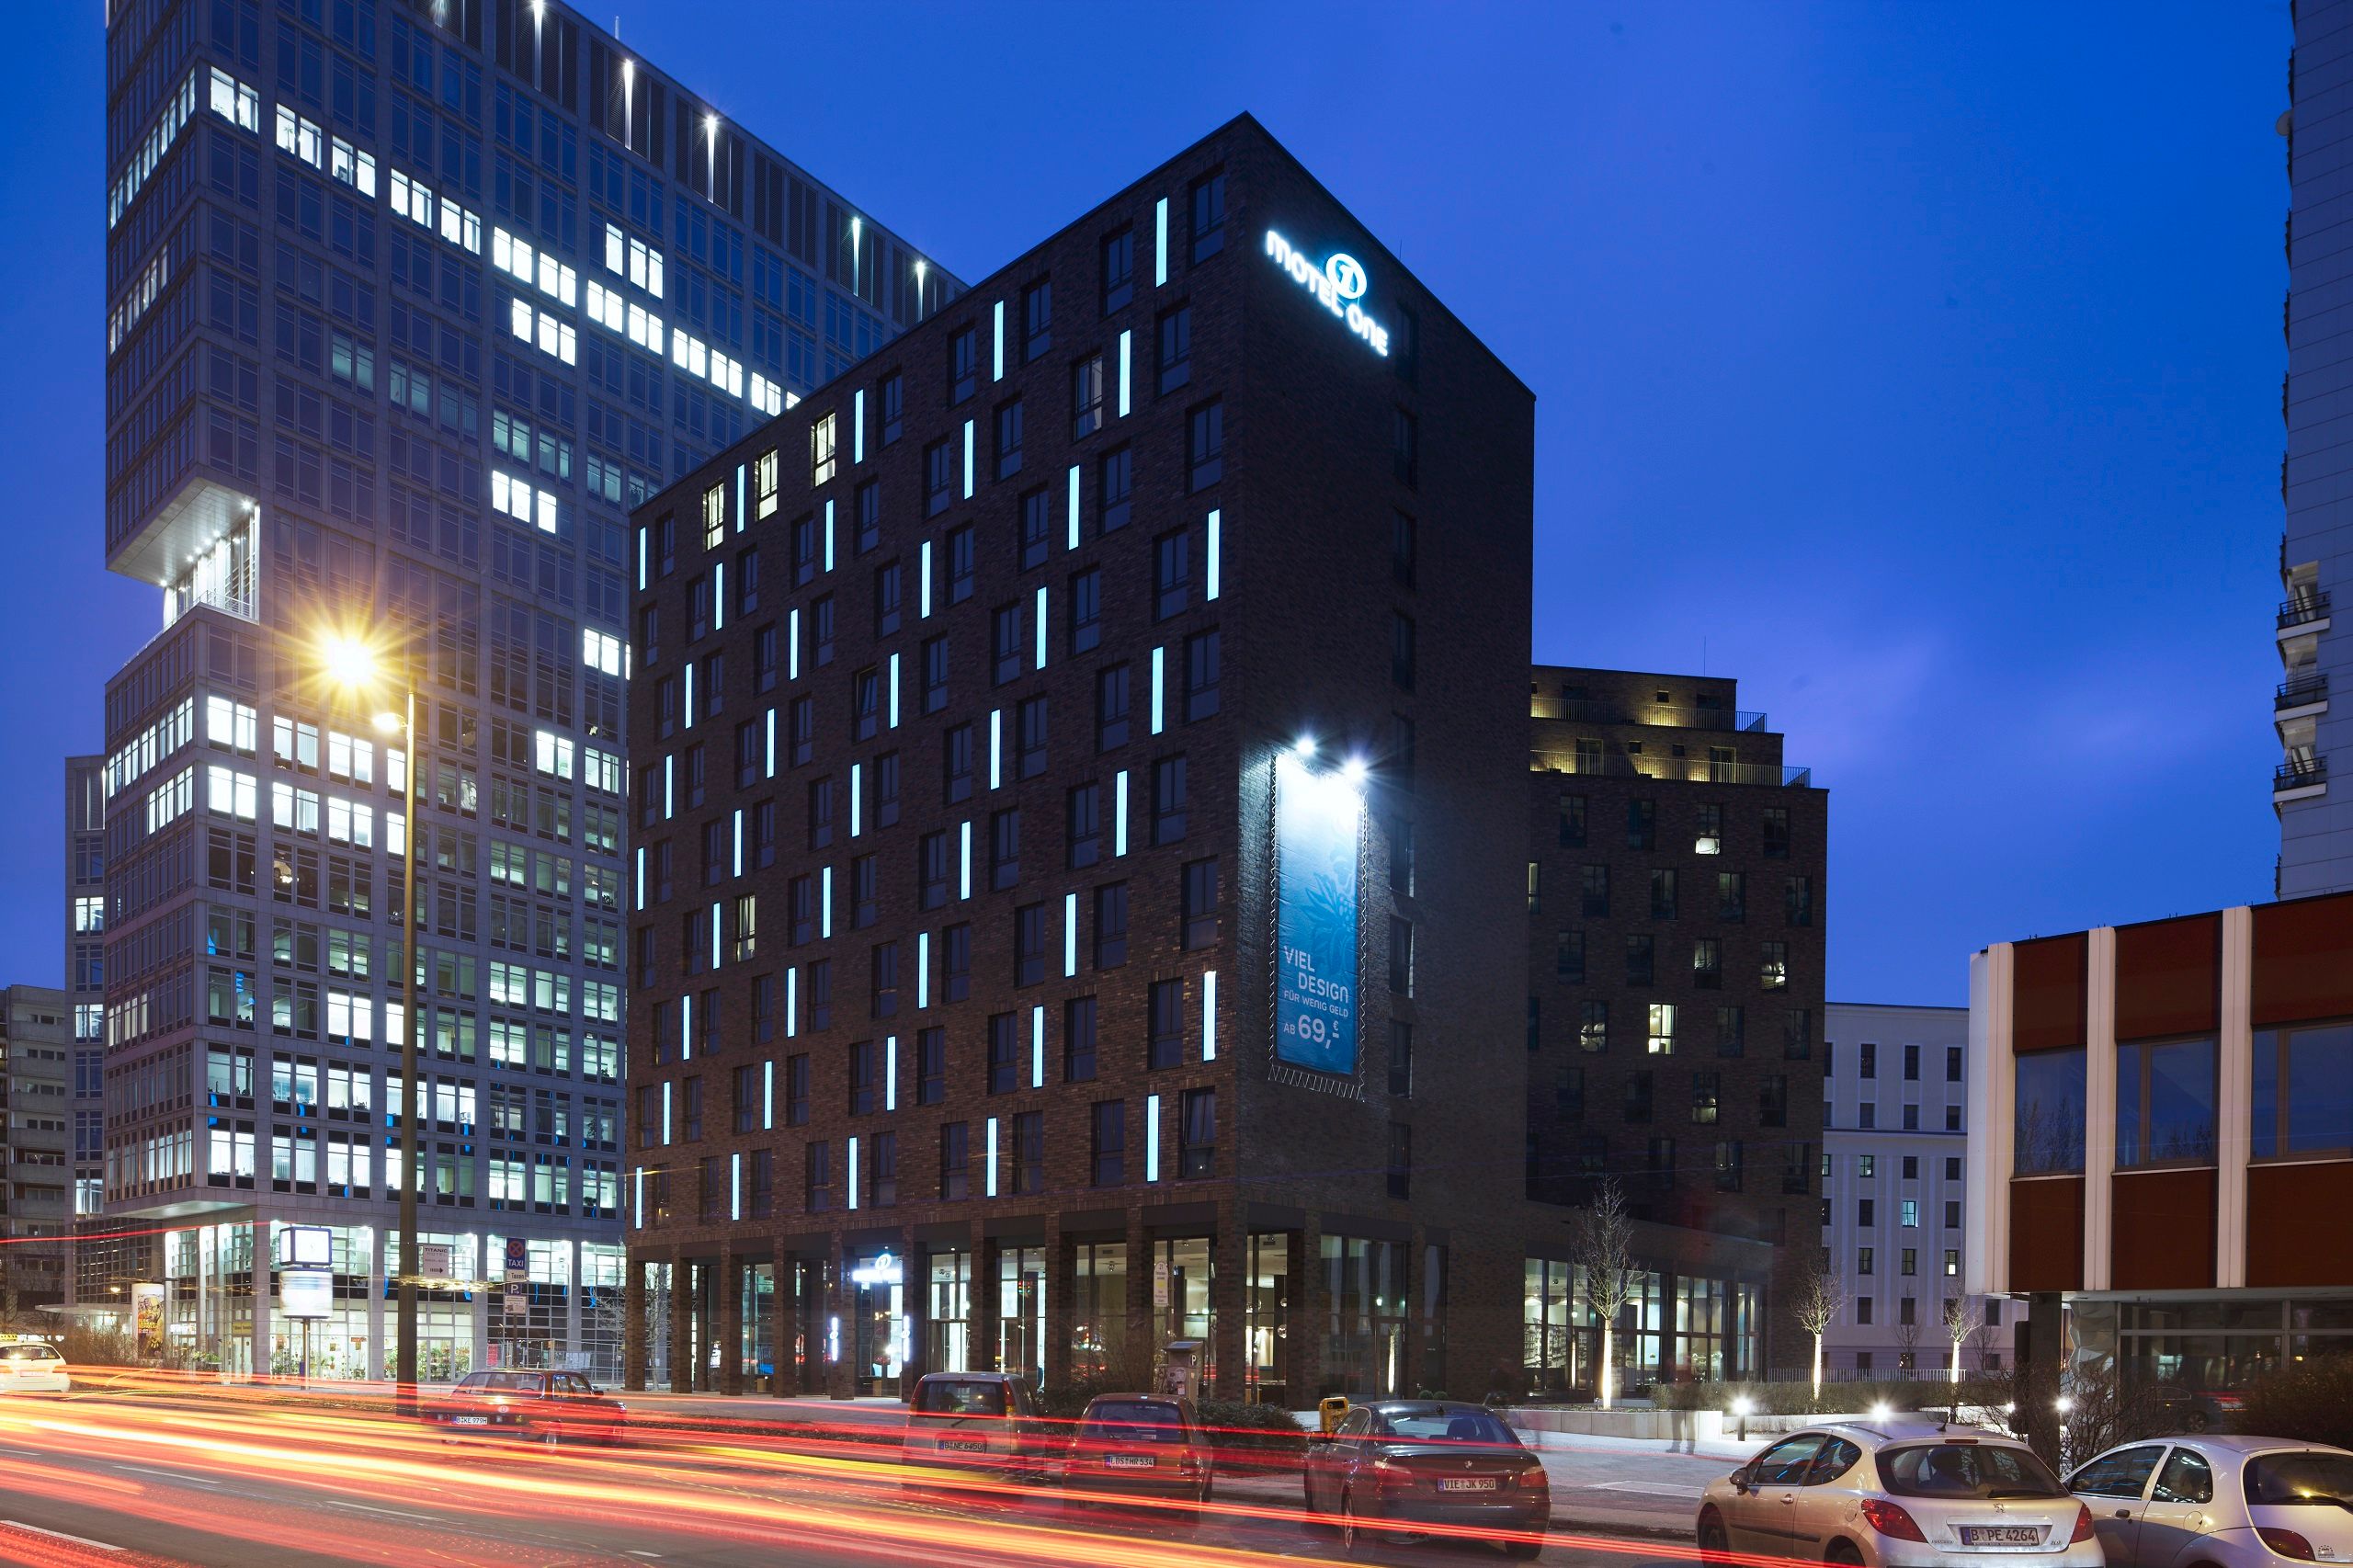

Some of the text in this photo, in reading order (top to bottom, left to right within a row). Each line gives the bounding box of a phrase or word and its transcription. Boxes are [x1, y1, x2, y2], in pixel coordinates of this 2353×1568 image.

[1284, 946, 1315, 972] VIEL
[1298, 971, 1348, 1004] DESIGN
[1284, 990, 1349, 1017] FÜR WENIG GELD
[1283, 1023, 1296, 1035] AB
[507, 1258, 524, 1267] TAXI
[510, 1284, 519, 1294] P
[1191, 1355, 1197, 1366] P
[1444, 1479, 1495, 1489] VIE JK 950
[1971, 1528, 2036, 1542] B PE 4264
